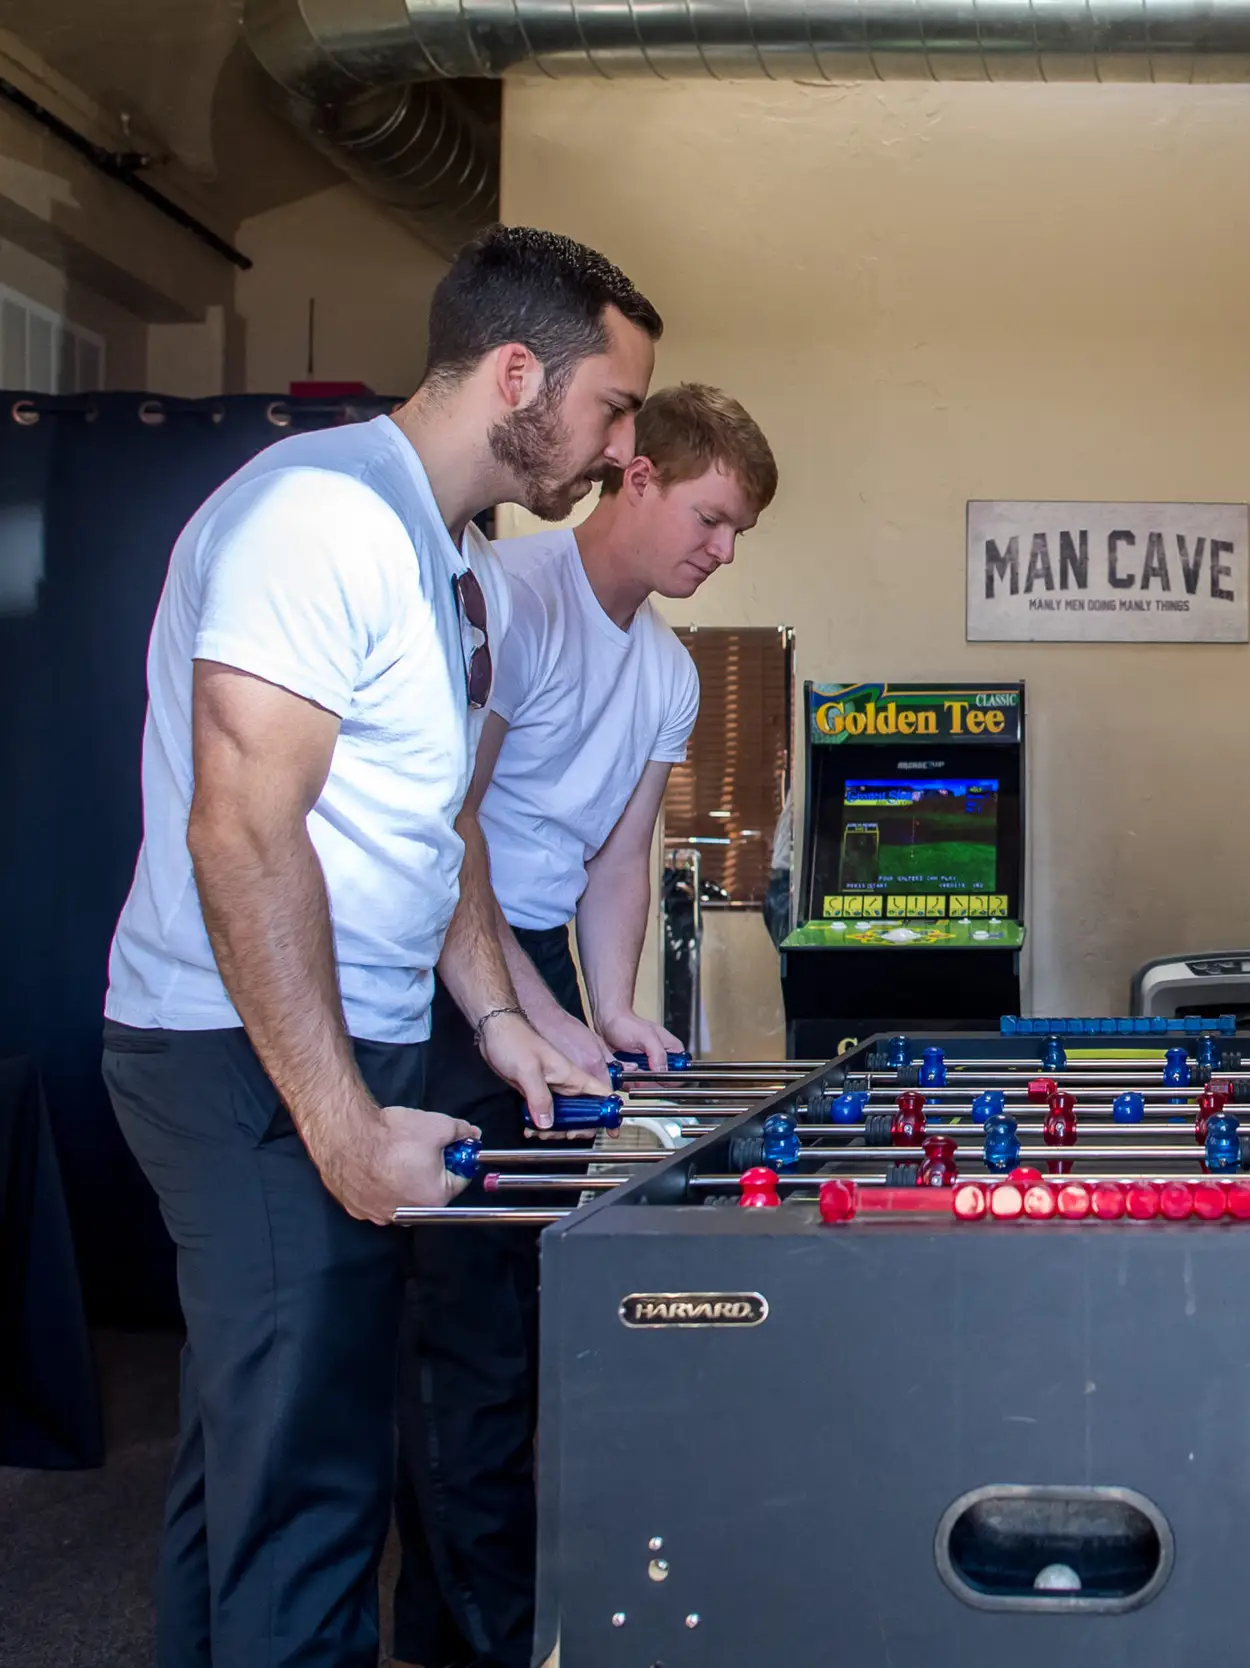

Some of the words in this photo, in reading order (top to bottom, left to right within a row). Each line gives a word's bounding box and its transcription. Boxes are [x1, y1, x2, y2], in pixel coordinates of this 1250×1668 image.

[985, 530, 1089, 600] MAN
[1107, 530, 1235, 602] CAVE
[1029, 598, 1062, 611] MANLY
[1065, 599, 1085, 612] MEN
[1087, 599, 1117, 612] DOING
[1119, 599, 1151, 612] MANLY
[1155, 600, 1190, 612] THINGS
[975, 693, 1017, 707] CLASSIC
[815, 700, 939, 735] Golden
[944, 701, 1006, 734] Tee
